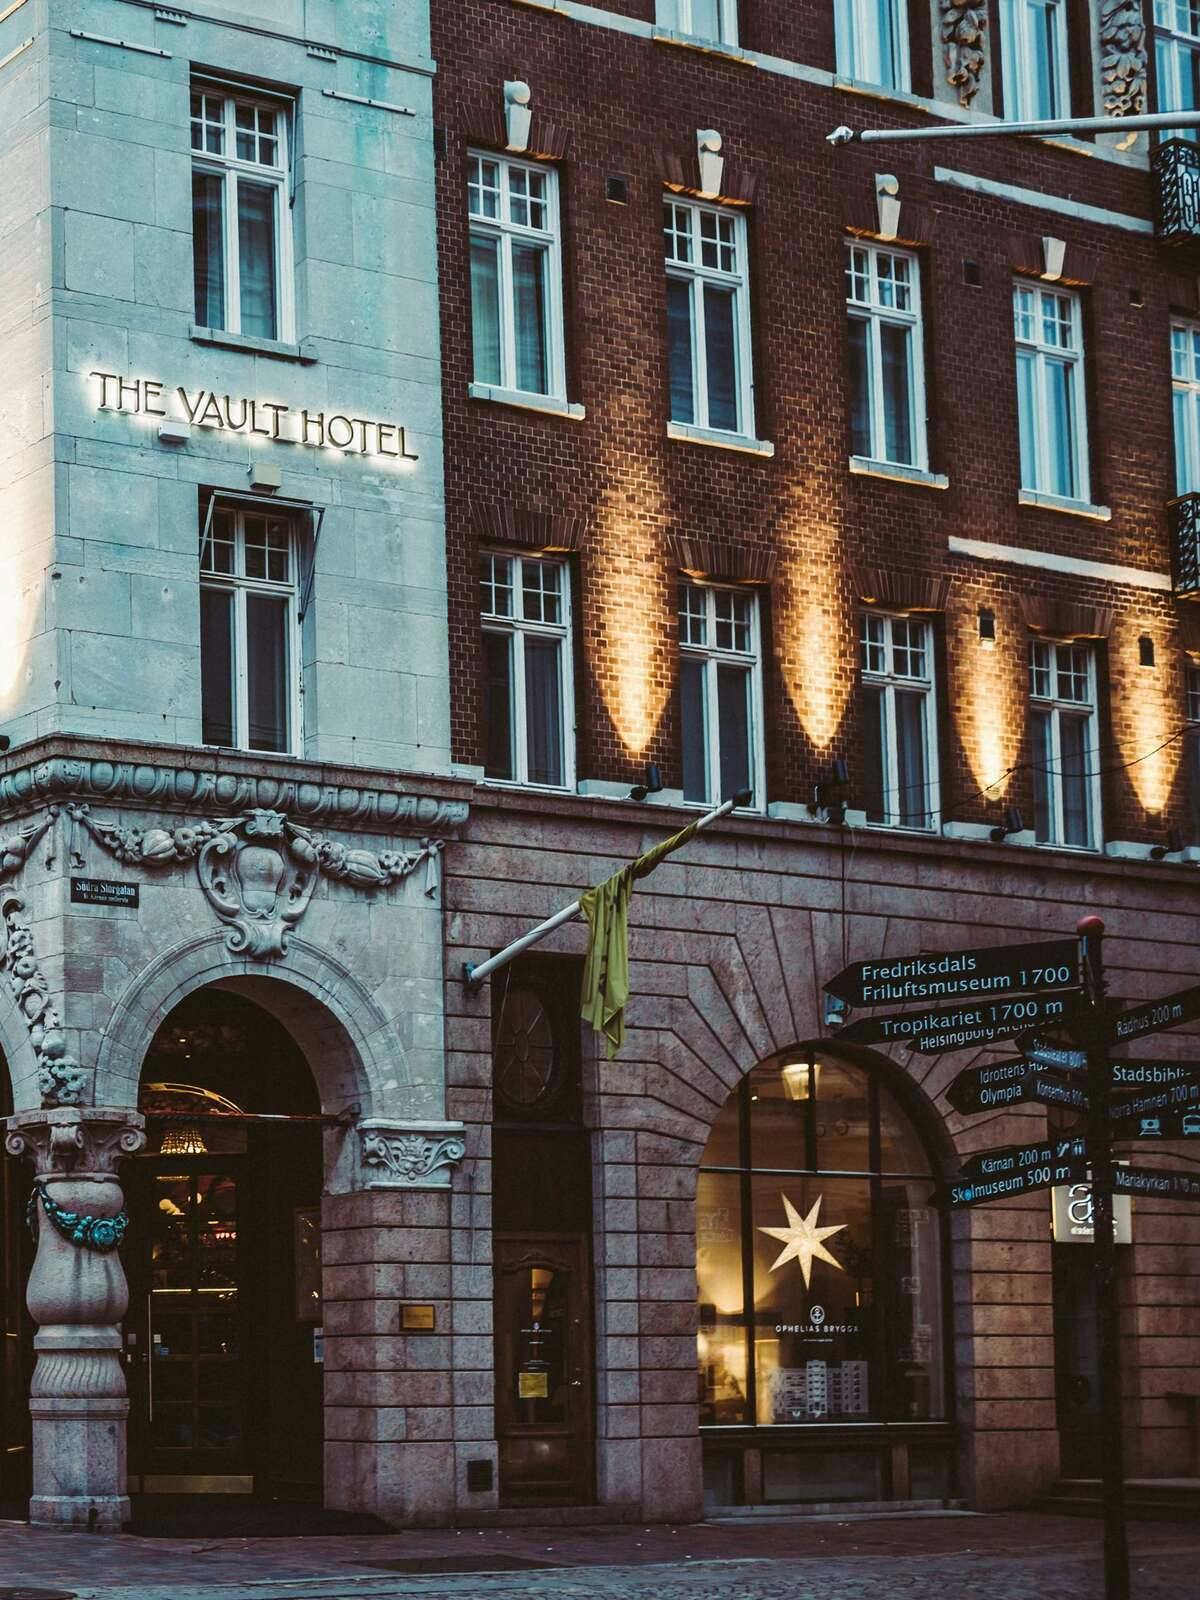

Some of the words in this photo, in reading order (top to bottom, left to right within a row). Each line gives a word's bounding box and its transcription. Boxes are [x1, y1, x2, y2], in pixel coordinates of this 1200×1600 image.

[89, 371, 166, 416] THE
[177, 386, 288, 439] VAULT
[302, 409, 419, 461] HOTEL
[861, 955, 977, 981] Fredriksdals
[862, 976, 1010, 1001] Friluftsmuseum
[1019, 966, 1070, 986] 1700
[880, 1010, 982, 1039] Tropikariet
[990, 1001, 1038, 1021] 1700
[1046, 1001, 1063, 1014] m
[1152, 1005, 1170, 1024] 200
[1172, 1004, 1182, 1017] m
[980, 1063, 1025, 1084] Idrottens
[980, 1085, 1023, 1104] Olympia
[1018, 1149, 1038, 1167] 200
[1041, 1151, 1052, 1161] m
[951, 1176, 1024, 1203] Sklmuseum
[1027, 1167, 1051, 1186] 500
[1055, 1166, 1071, 1179] m
[775, 1325, 820, 1333] OPHELIAS
